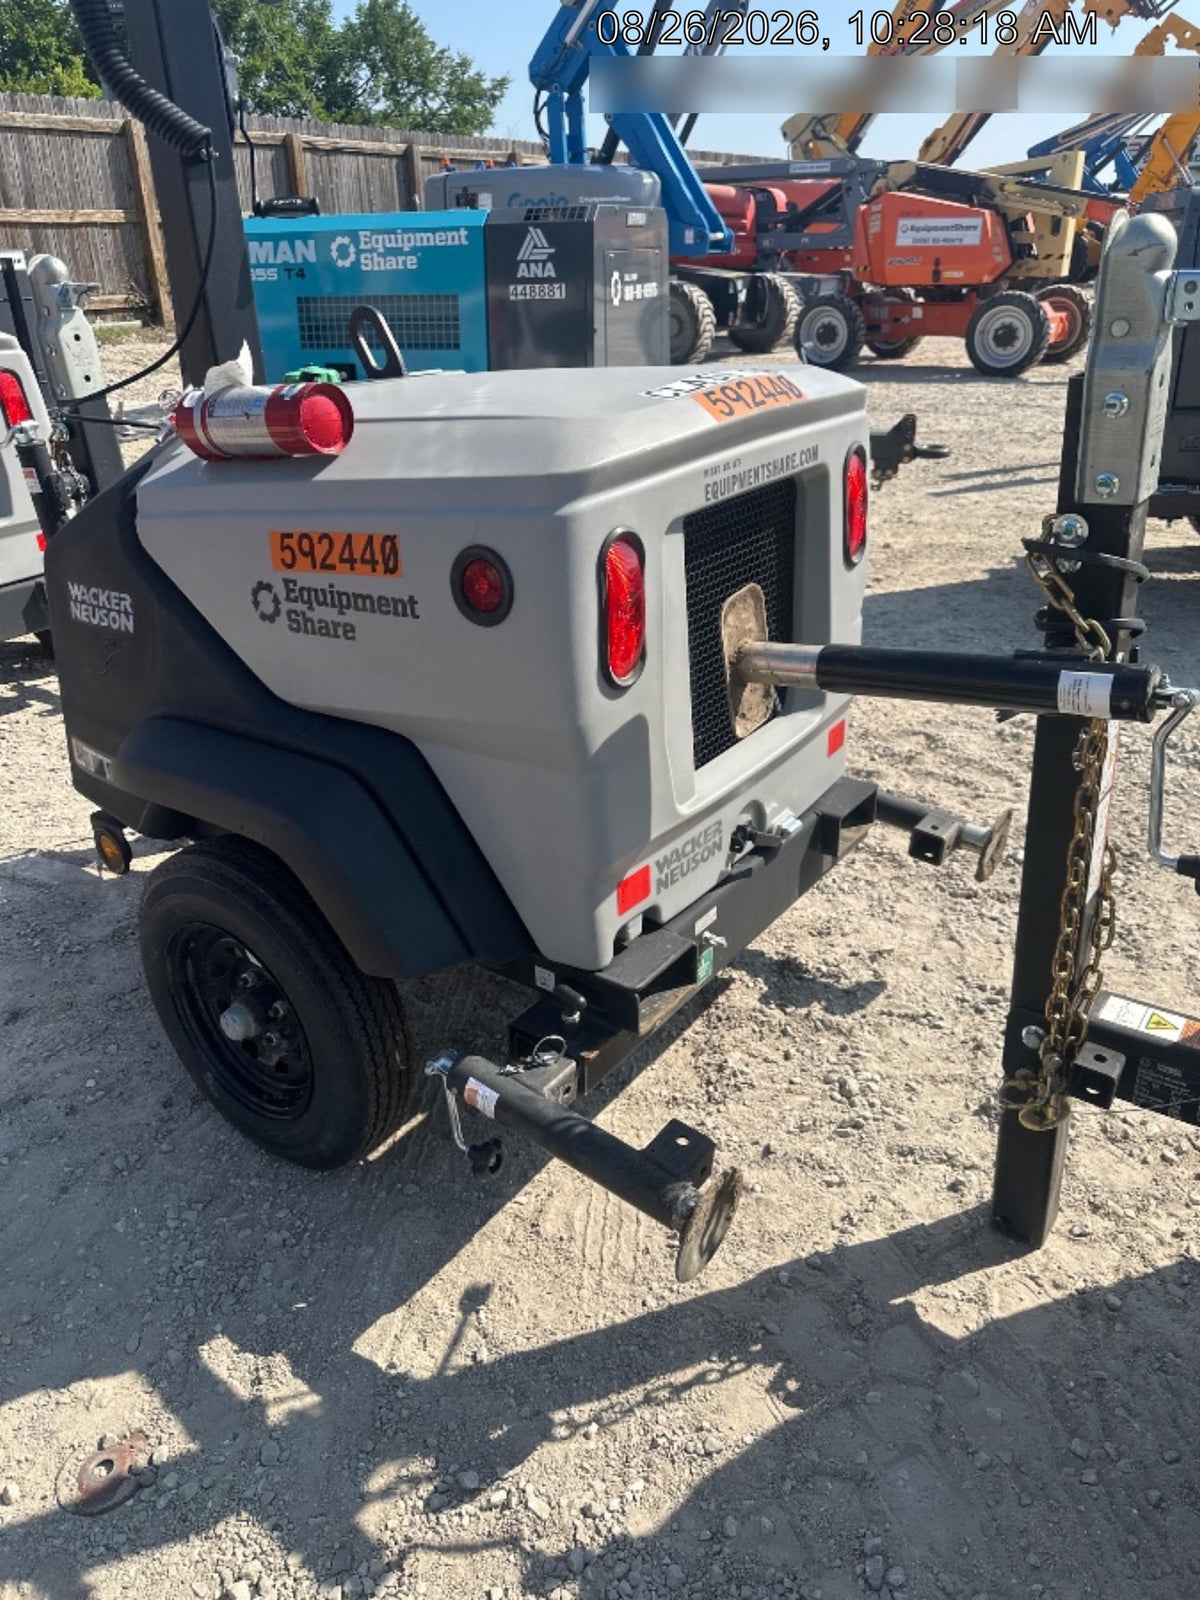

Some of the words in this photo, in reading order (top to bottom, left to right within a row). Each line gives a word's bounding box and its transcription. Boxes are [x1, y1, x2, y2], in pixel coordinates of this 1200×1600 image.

[248, 240, 317, 264] MAN
[358, 227, 469, 252] Equipment
[284, 267, 306, 280] T4
[360, 251, 418, 271] Share
[517, 262, 556, 278] ANA
[510, 284, 565, 300] 448881
[703, 375, 803, 416] 592440
[704, 445, 819, 502] EQUIPMENTSHARE.COM
[280, 532, 399, 575] 592440
[67, 581, 133, 614] WACKER
[282, 577, 420, 619] Equipment
[69, 601, 134, 634] NEUSON
[286, 608, 357, 641] Share
[655, 820, 723, 875] WACKER
[656, 836, 722, 895] NEUSON
